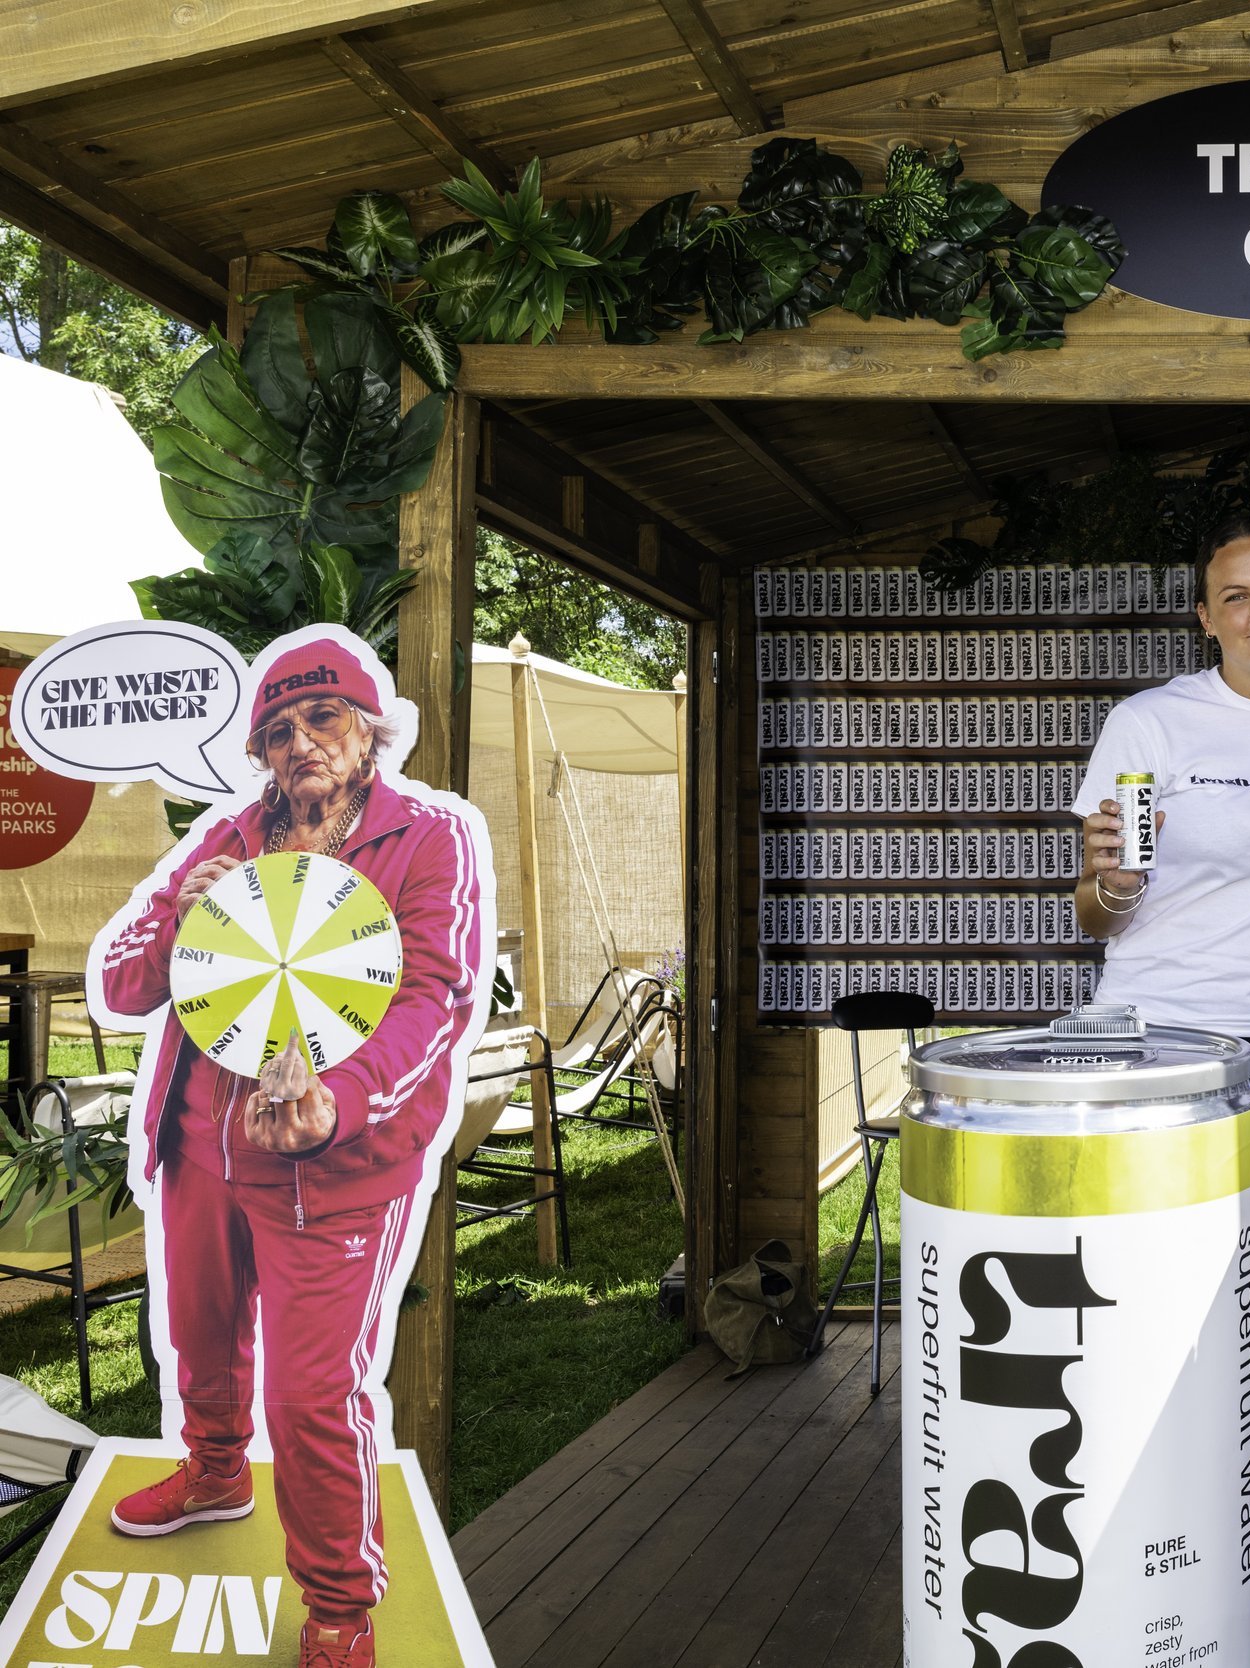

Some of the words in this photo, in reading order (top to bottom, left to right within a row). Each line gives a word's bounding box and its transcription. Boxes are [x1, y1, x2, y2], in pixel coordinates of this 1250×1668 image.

[813, 574, 823, 613] trash
[853, 574, 863, 612] trash
[813, 639, 824, 677] trash
[853, 639, 864, 678] trash
[890, 639, 900, 678] trash
[927, 638, 938, 677] trash
[41, 676, 108, 704] GIVE
[115, 667, 219, 697] WASTE
[263, 665, 339, 704] trash
[41, 703, 97, 731] THE
[104, 695, 207, 726] FINGER
[872, 704, 882, 743] trash
[910, 704, 920, 744] trash
[949, 704, 960, 744] trash
[1, 788, 20, 798] THE
[949, 769, 960, 808] trash
[986, 769, 997, 808] trash
[1023, 768, 1034, 808] trash
[1, 802, 57, 816] ROYAL
[2, 820, 56, 834] PARKS
[1137, 787, 1154, 865] trash
[293, 855, 311, 884] WIN
[950, 836, 960, 875] trash
[987, 836, 997, 875] trash
[243, 862, 263, 901] LOSE
[327, 875, 360, 910] LOSE
[199, 895, 231, 927] LOSE
[351, 918, 391, 941] LOSE
[968, 901, 978, 940] trash
[1005, 901, 1015, 940] trash
[1045, 901, 1055, 940] trash
[174, 946, 214, 965] LOSE
[366, 967, 395, 985] WIN
[968, 967, 978, 1007] trash
[178, 997, 211, 1016] WIN
[338, 1004, 374, 1037] LOSE
[207, 1023, 242, 1059] LOSE
[306, 1031, 328, 1071] LOSE
[917, 1241, 947, 1473] superfruit
[960, 1236, 1117, 1668] tra
[923, 1486, 947, 1619] water
[1145, 1535, 1186, 1558] PURE
[1145, 1562, 1156, 1577] &
[1159, 1550, 1201, 1573] STILL
[45, 1570, 283, 1655] SPIN
[1145, 1614, 1183, 1634] crisp,
[1145, 1634, 1183, 1655] zesty
[1189, 1640, 1218, 1662] from
